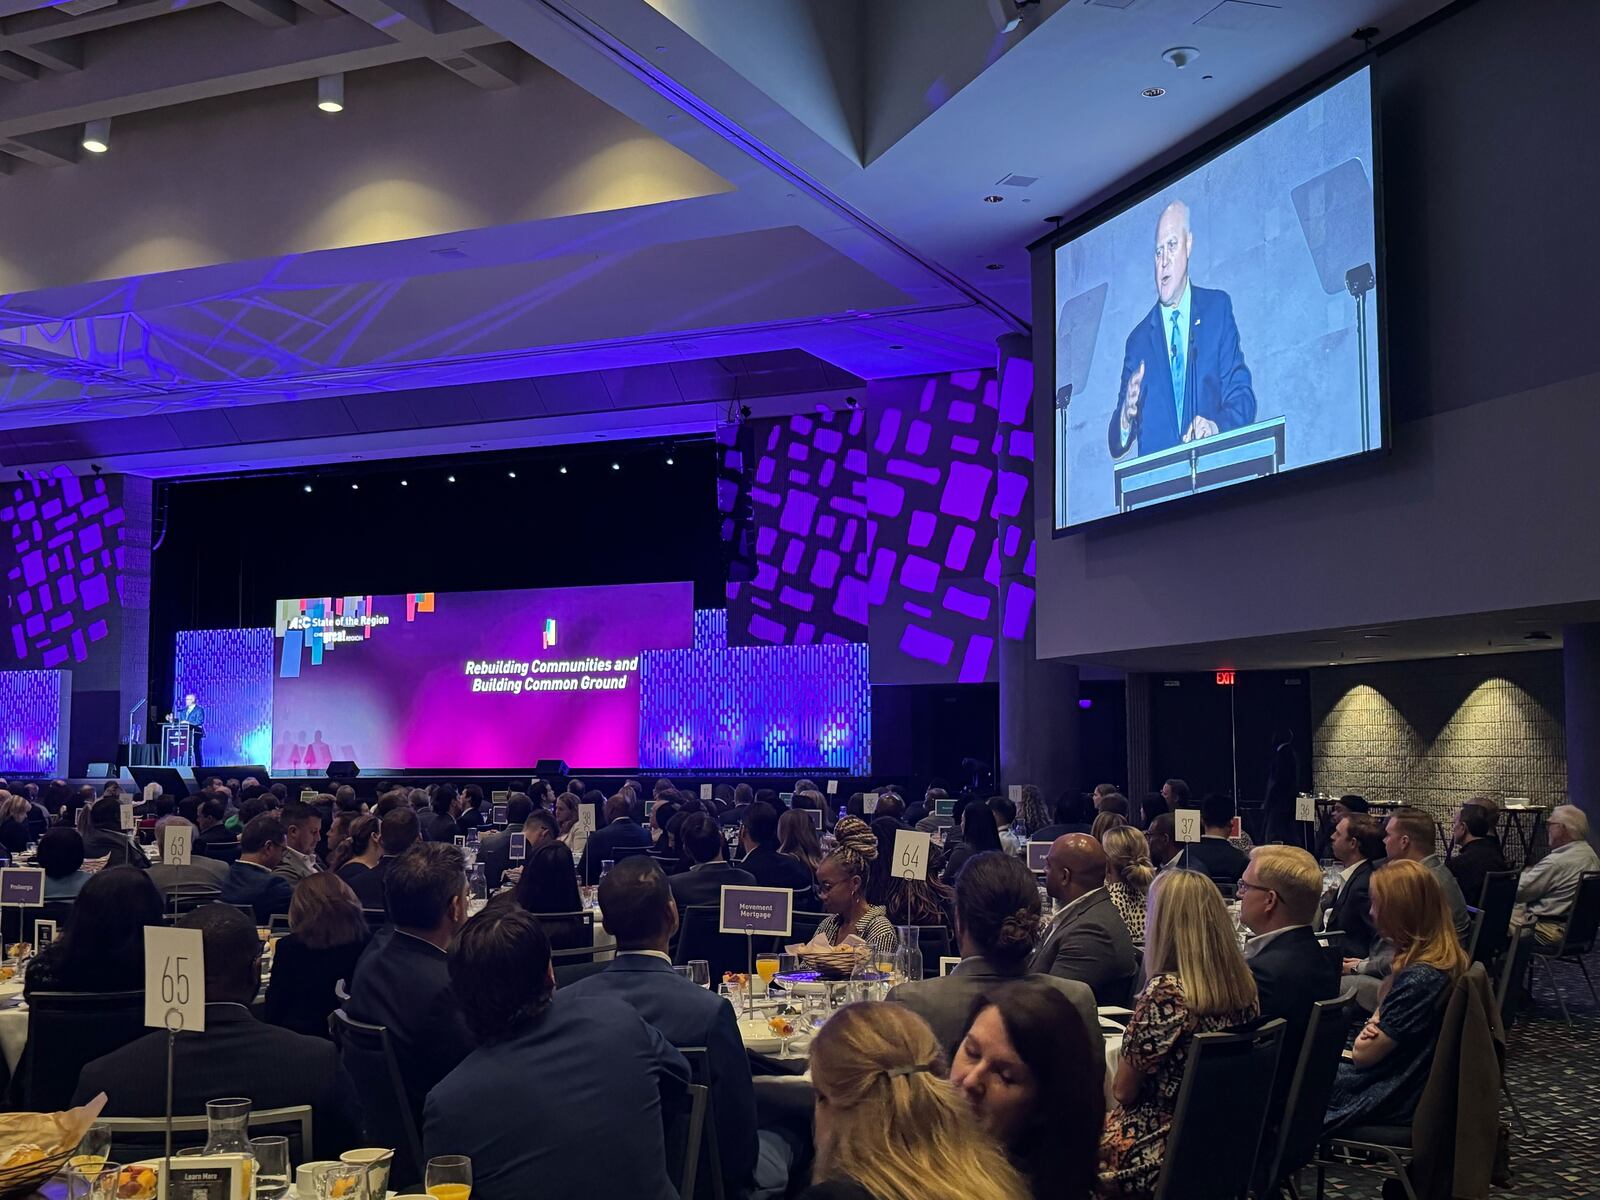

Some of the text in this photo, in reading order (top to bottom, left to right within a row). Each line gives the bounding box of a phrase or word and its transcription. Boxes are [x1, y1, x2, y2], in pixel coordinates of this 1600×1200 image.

[312, 617, 333, 627] State
[335, 617, 344, 626] of
[345, 615, 359, 626] the
[360, 614, 389, 627] Region
[465, 656, 638, 676] Rebuilding Communities and
[472, 675, 627, 694] Building Common Ground
[1216, 672, 1235, 684] EXIT
[1300, 803, 1310, 815] 36
[582, 811, 591, 825] 38
[1181, 818, 1194, 834] 37
[170, 836, 184, 856] 63
[901, 844, 919, 868] 64
[739, 903, 773, 911] Movement
[740, 910, 771, 919] Mortgage
[161, 956, 190, 1005] 65
